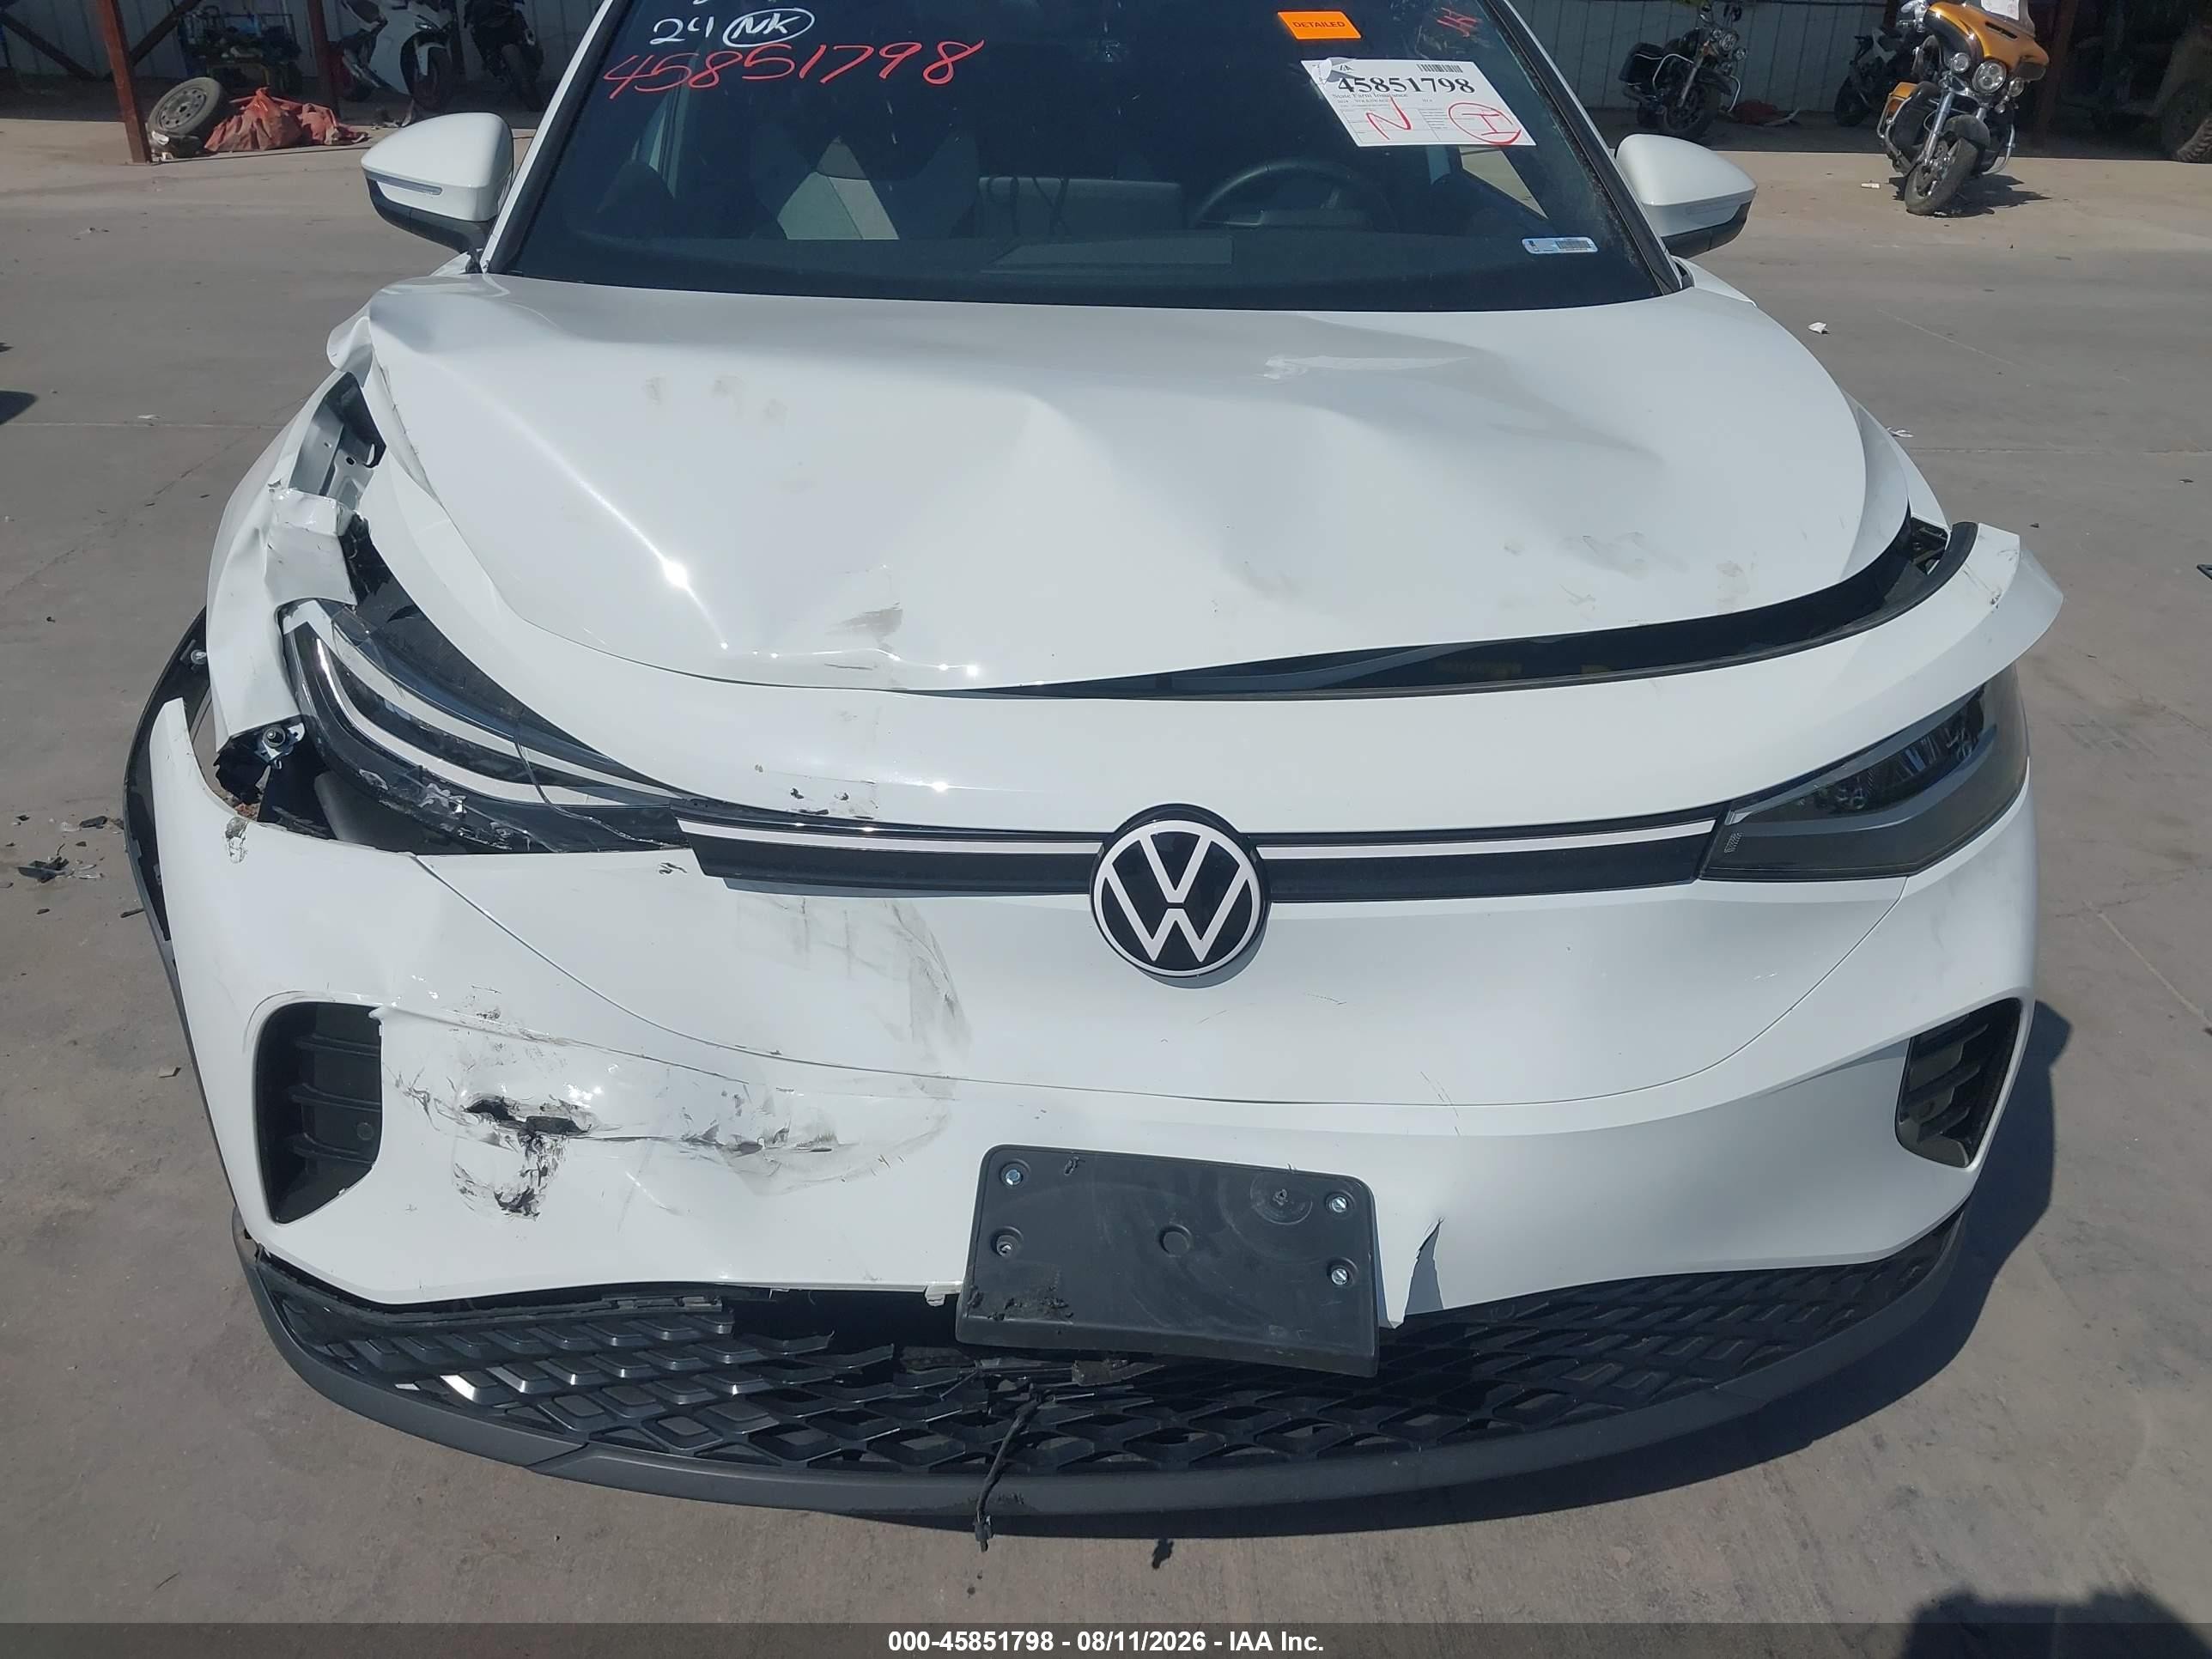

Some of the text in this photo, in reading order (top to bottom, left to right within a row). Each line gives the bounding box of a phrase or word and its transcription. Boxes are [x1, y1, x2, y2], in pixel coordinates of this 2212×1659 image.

[649, 15, 714, 45] 24
[603, 40, 984, 100] 45851798
[1338, 76, 1476, 94] 45851798
